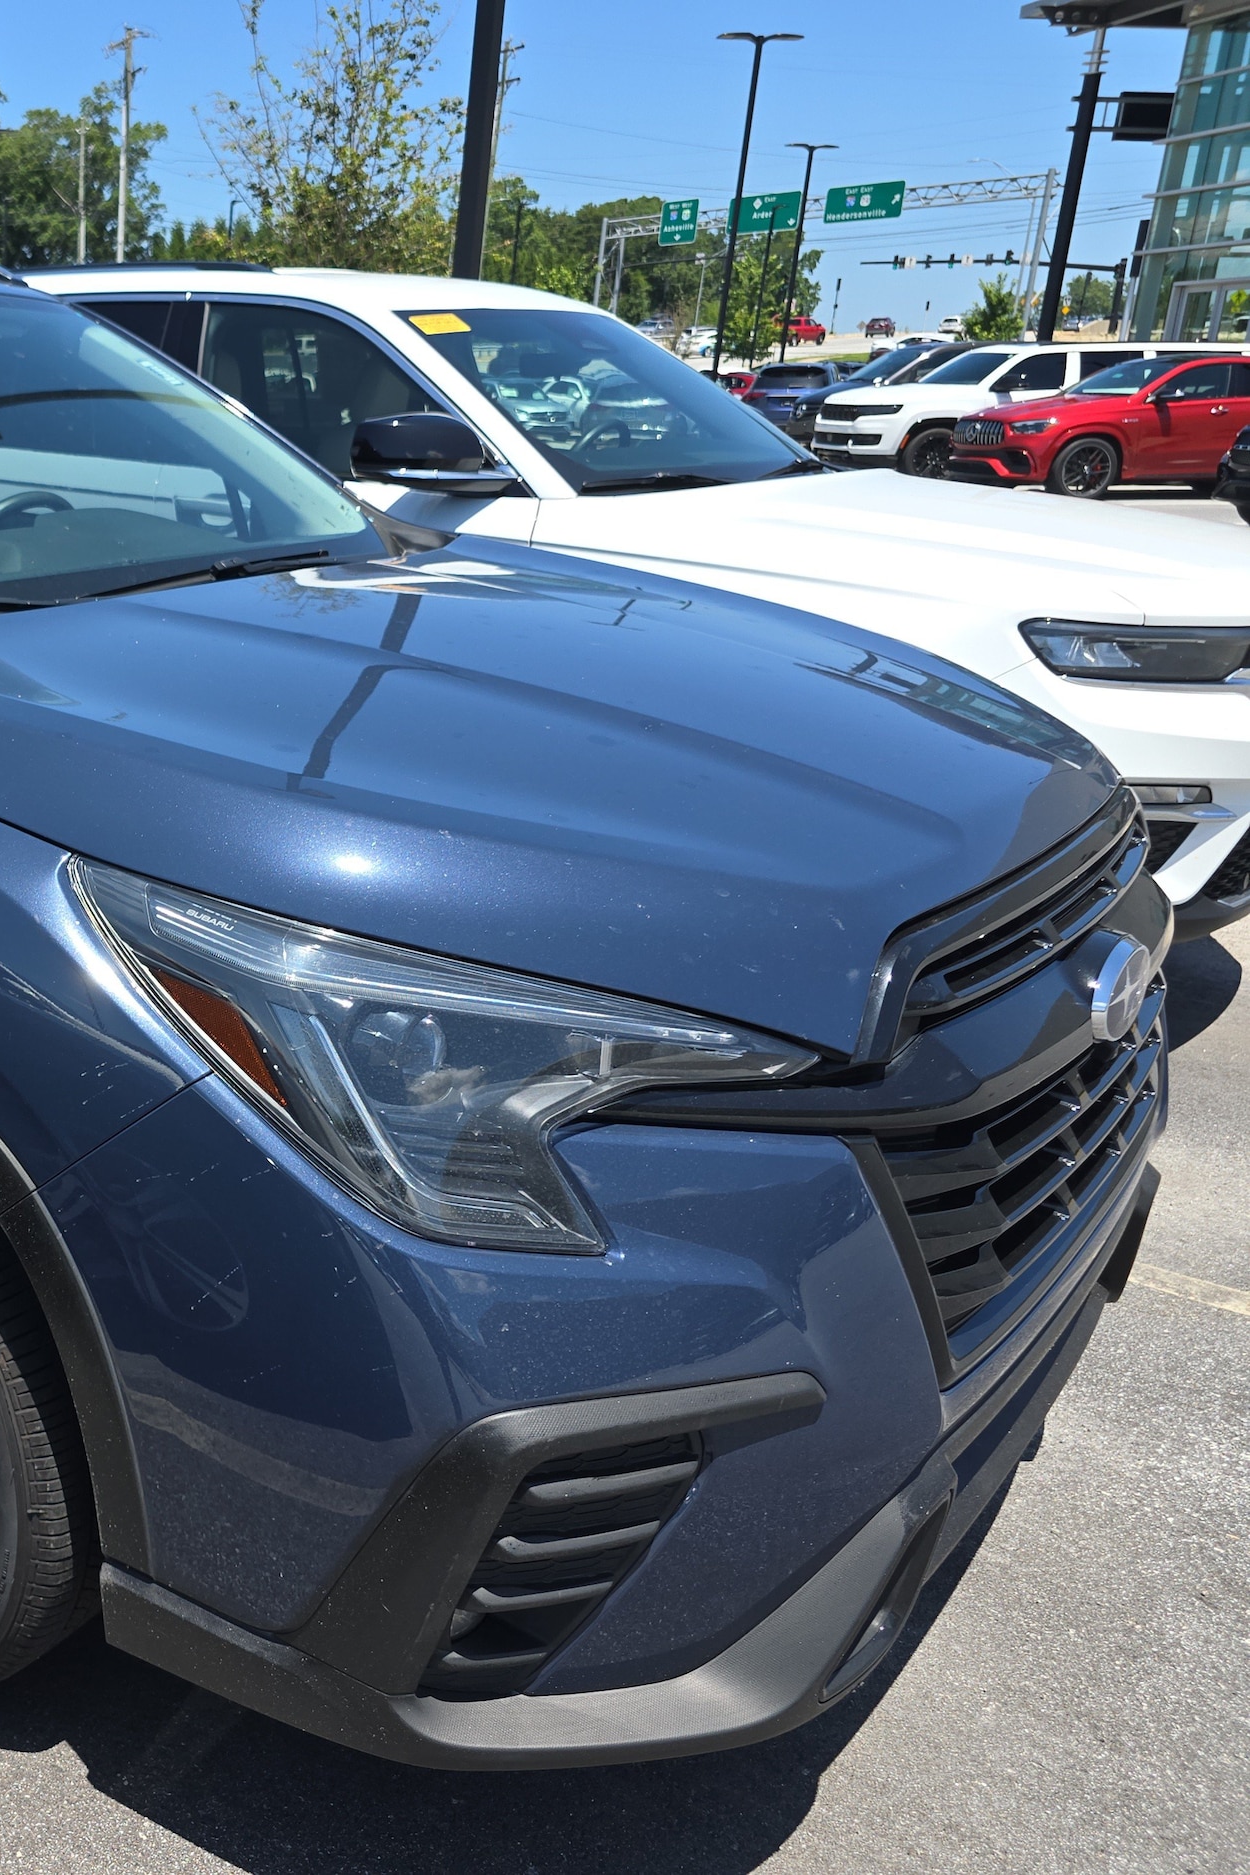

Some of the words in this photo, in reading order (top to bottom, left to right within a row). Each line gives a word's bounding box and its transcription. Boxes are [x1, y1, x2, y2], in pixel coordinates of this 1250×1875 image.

[826, 208, 886, 221] Hendersonville
[663, 223, 694, 233] Asheville
[186, 909, 234, 931] SUBARU
